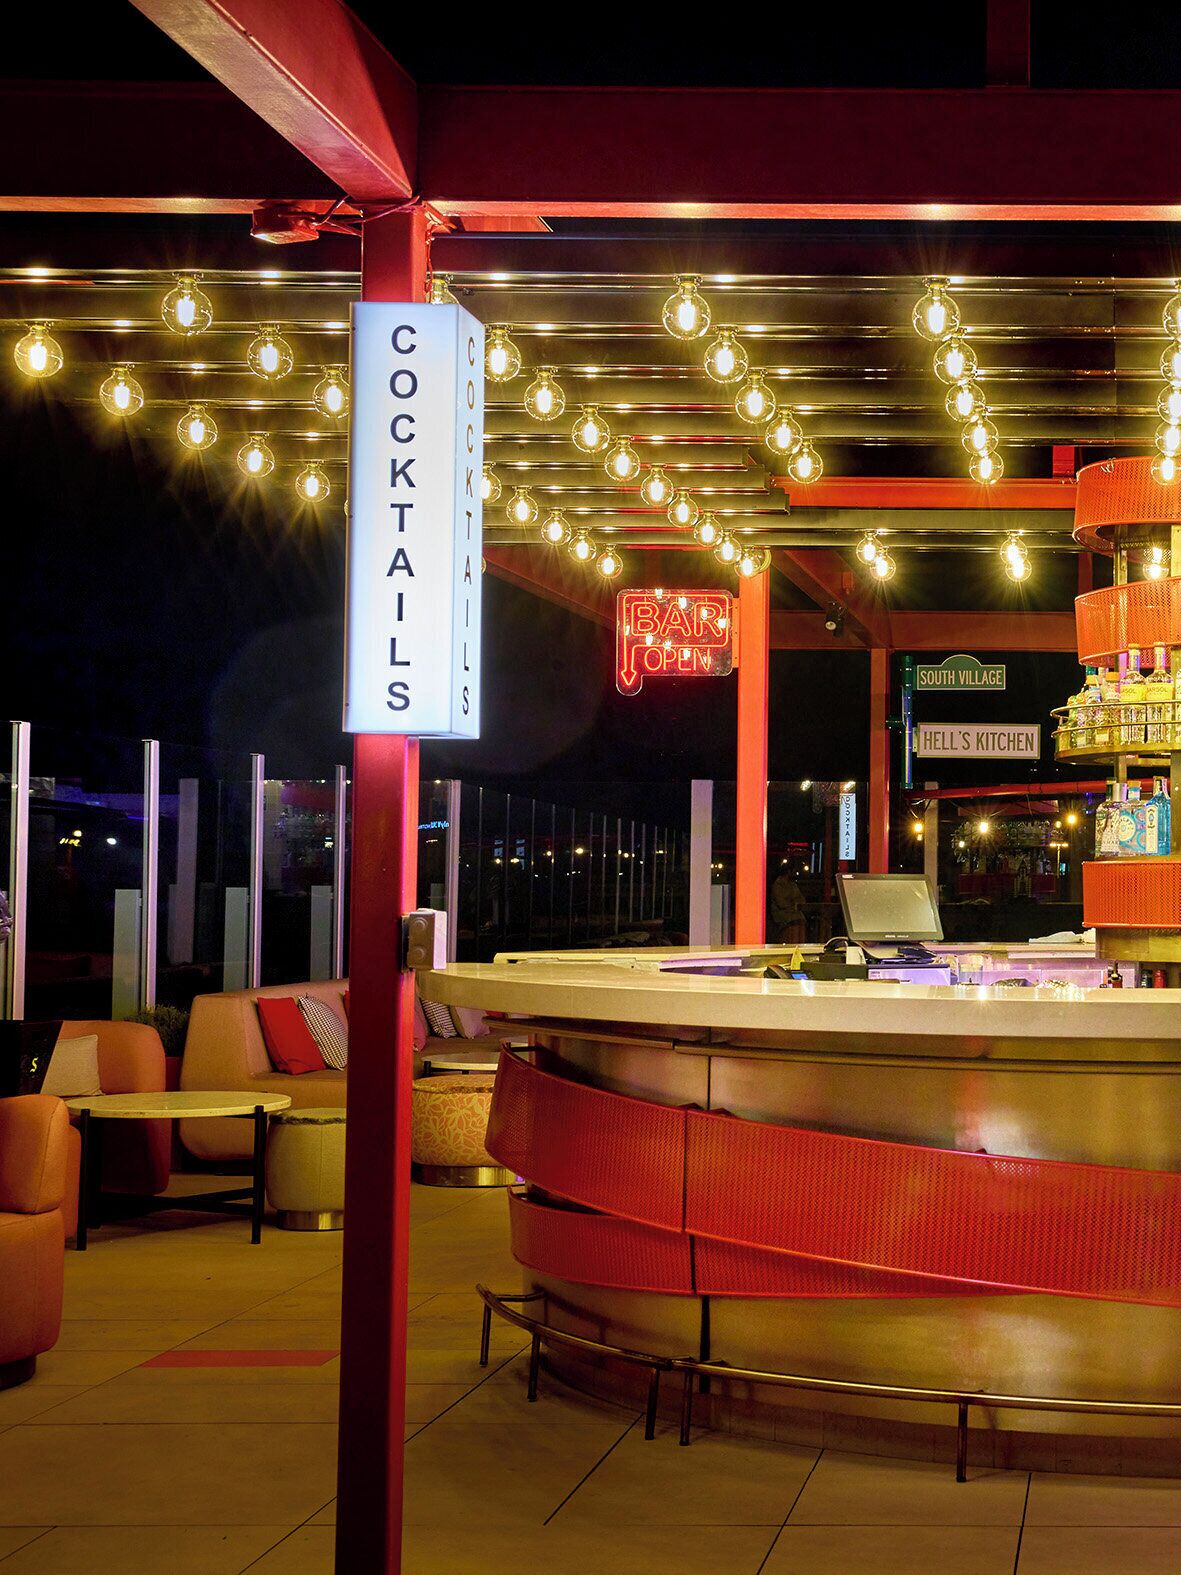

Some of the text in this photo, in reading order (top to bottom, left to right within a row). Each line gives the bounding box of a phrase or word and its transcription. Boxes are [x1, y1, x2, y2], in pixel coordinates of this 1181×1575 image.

[386, 324, 419, 712] COCKTAILS
[461, 336, 476, 716] COCKTAILS
[631, 601, 723, 638] BAR
[644, 647, 711, 671] OPEN
[920, 670, 1003, 685] SOUTH VILLAGE
[923, 730, 1034, 752] HELL'S KITCHEN
